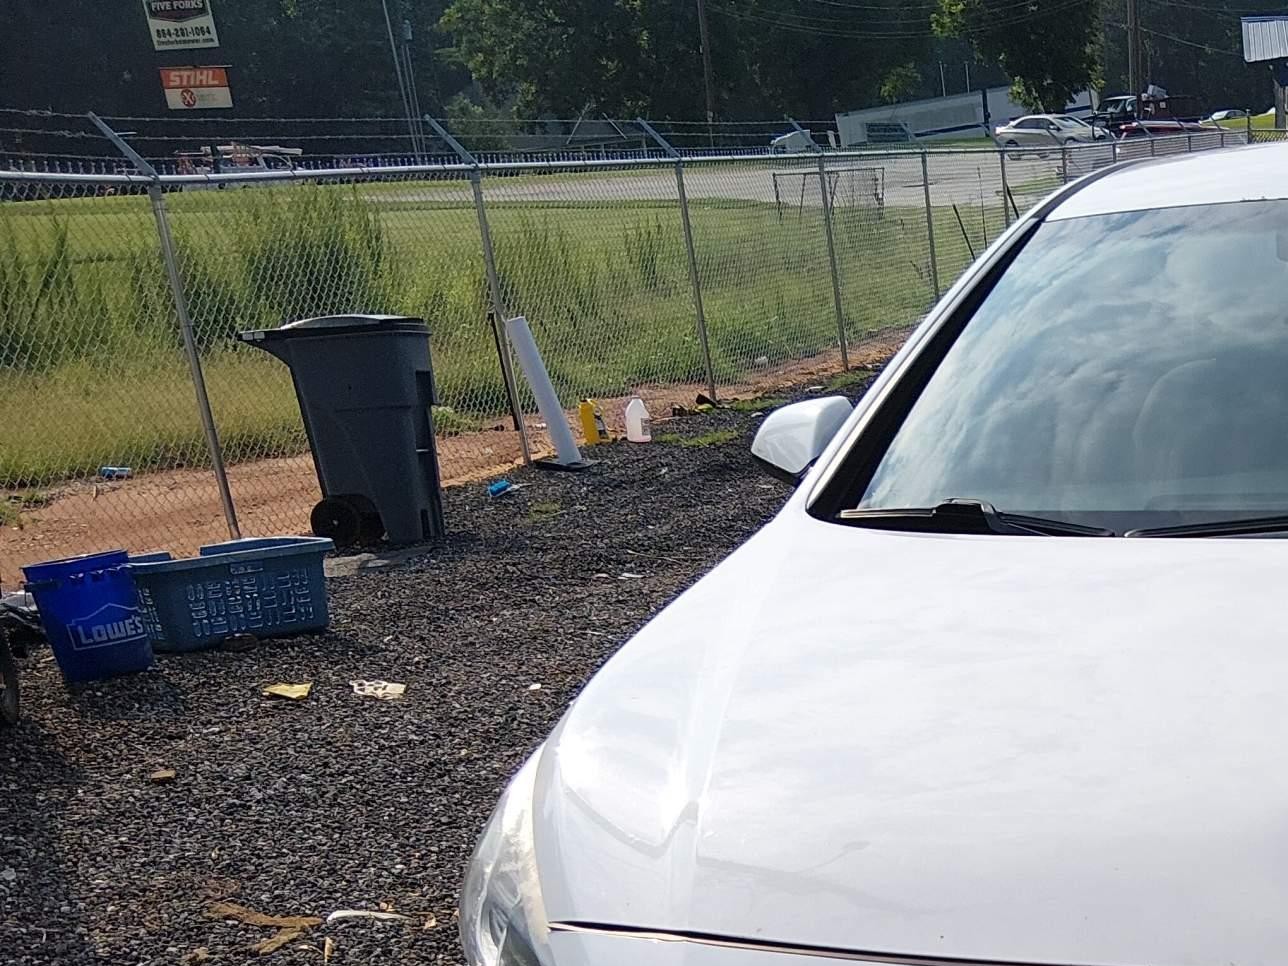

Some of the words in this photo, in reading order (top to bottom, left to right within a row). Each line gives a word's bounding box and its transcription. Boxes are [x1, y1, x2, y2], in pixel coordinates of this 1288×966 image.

[151, 1, 172, 11] FIVE
[172, 0, 203, 9] FORKS
[169, 70, 219, 86] STIHL
[78, 615, 144, 645] LOWE'S
